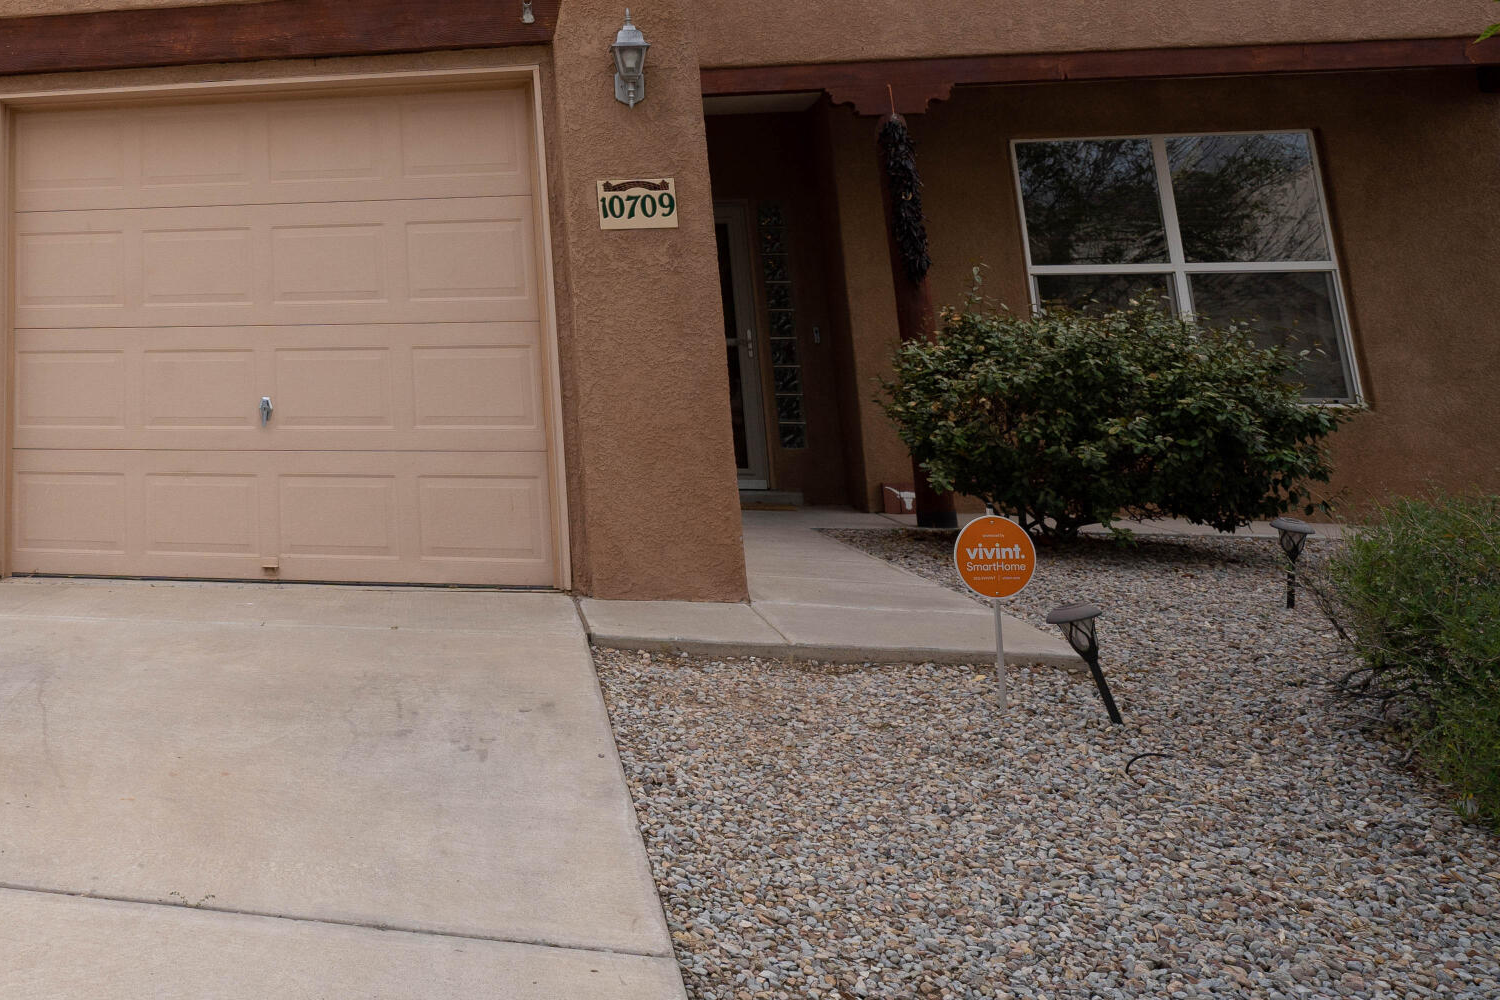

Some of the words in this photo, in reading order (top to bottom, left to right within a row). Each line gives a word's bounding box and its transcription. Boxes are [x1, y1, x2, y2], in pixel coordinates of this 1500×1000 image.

[600, 192, 675, 219] 10709
[965, 542, 1026, 560] vivint.
[966, 561, 1026, 572] SmartHome
